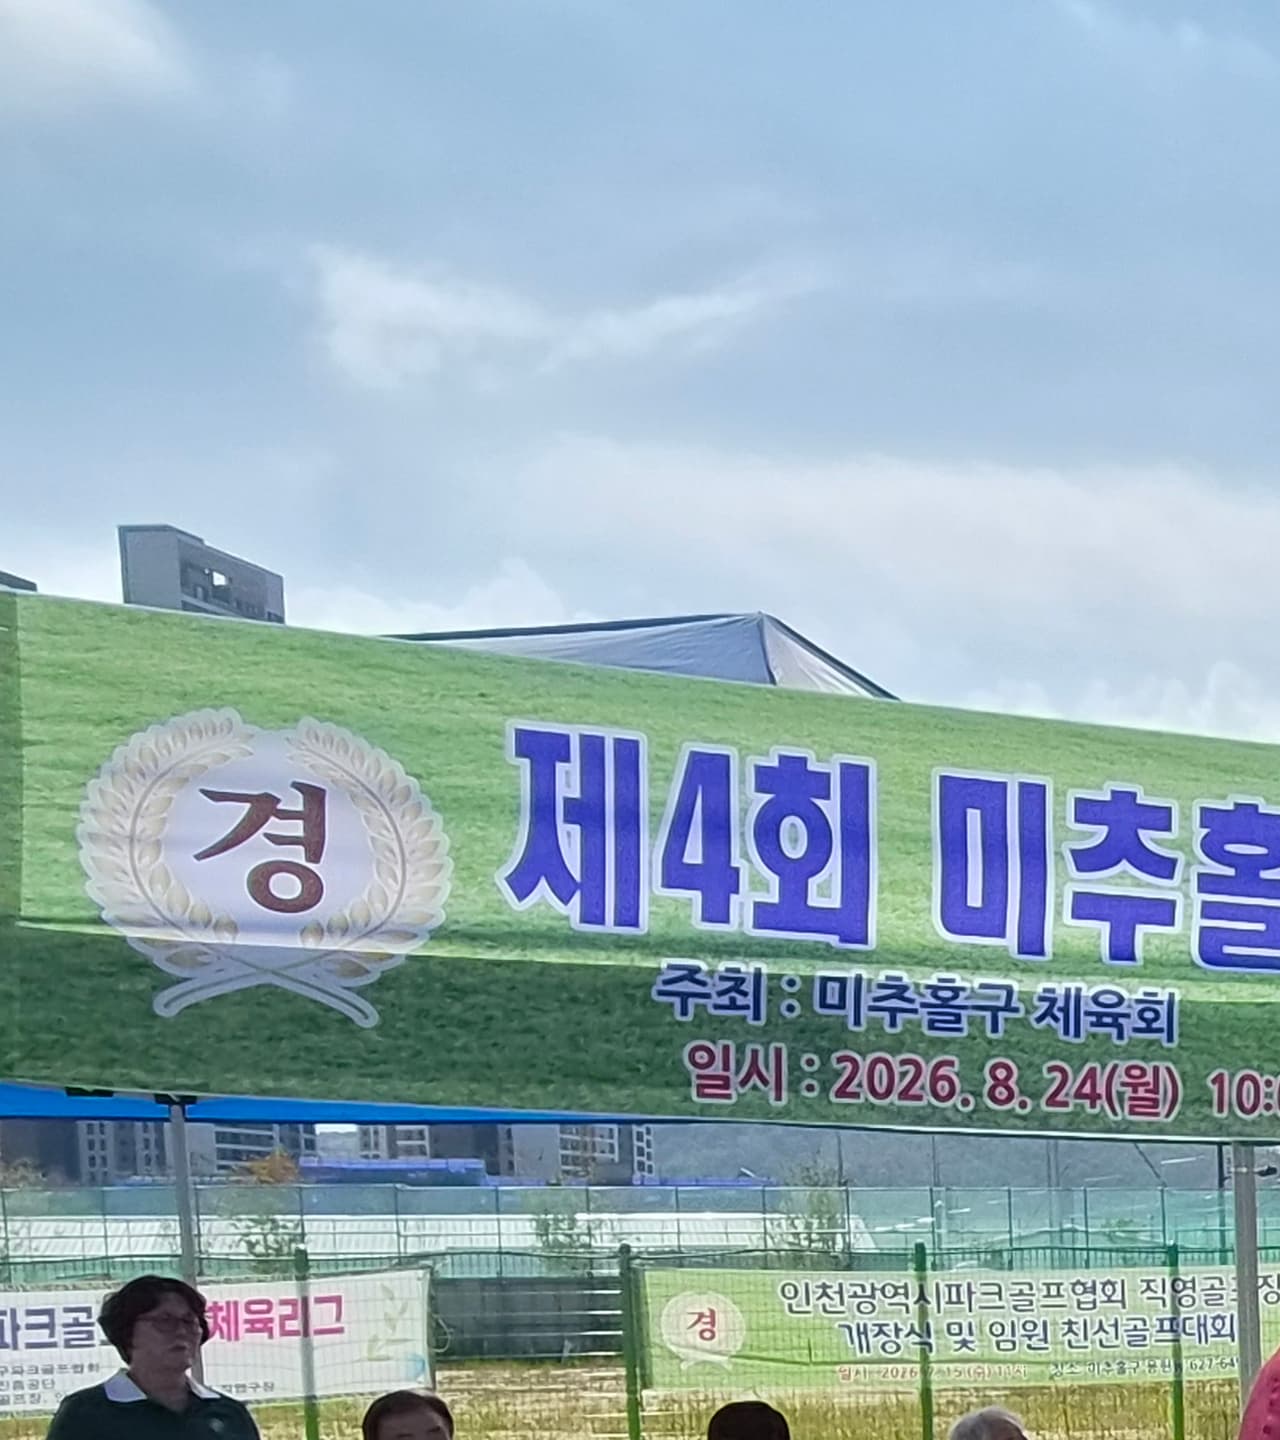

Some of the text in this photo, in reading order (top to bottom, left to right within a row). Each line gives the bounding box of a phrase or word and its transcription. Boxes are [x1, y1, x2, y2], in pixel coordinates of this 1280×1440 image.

[194, 780, 328, 914] 경
[505, 726, 873, 947] 제4회
[656, 963, 763, 1022] 주최
[818, 973, 1021, 1035] 미추홀구
[1033, 986, 1176, 1044] 체육회
[687, 1043, 784, 1102] 일시
[834, 1054, 972, 1108] 2026.
[987, 1060, 1029, 1111] 8.
[1044, 1062, 1180, 1119] 24(월)
[0, 1294, 345, 1351] 파크골 체육리그
[686, 1307, 717, 1342] 경
[838, 1313, 1237, 1354] 개장식 및 임원 친선골프대회
